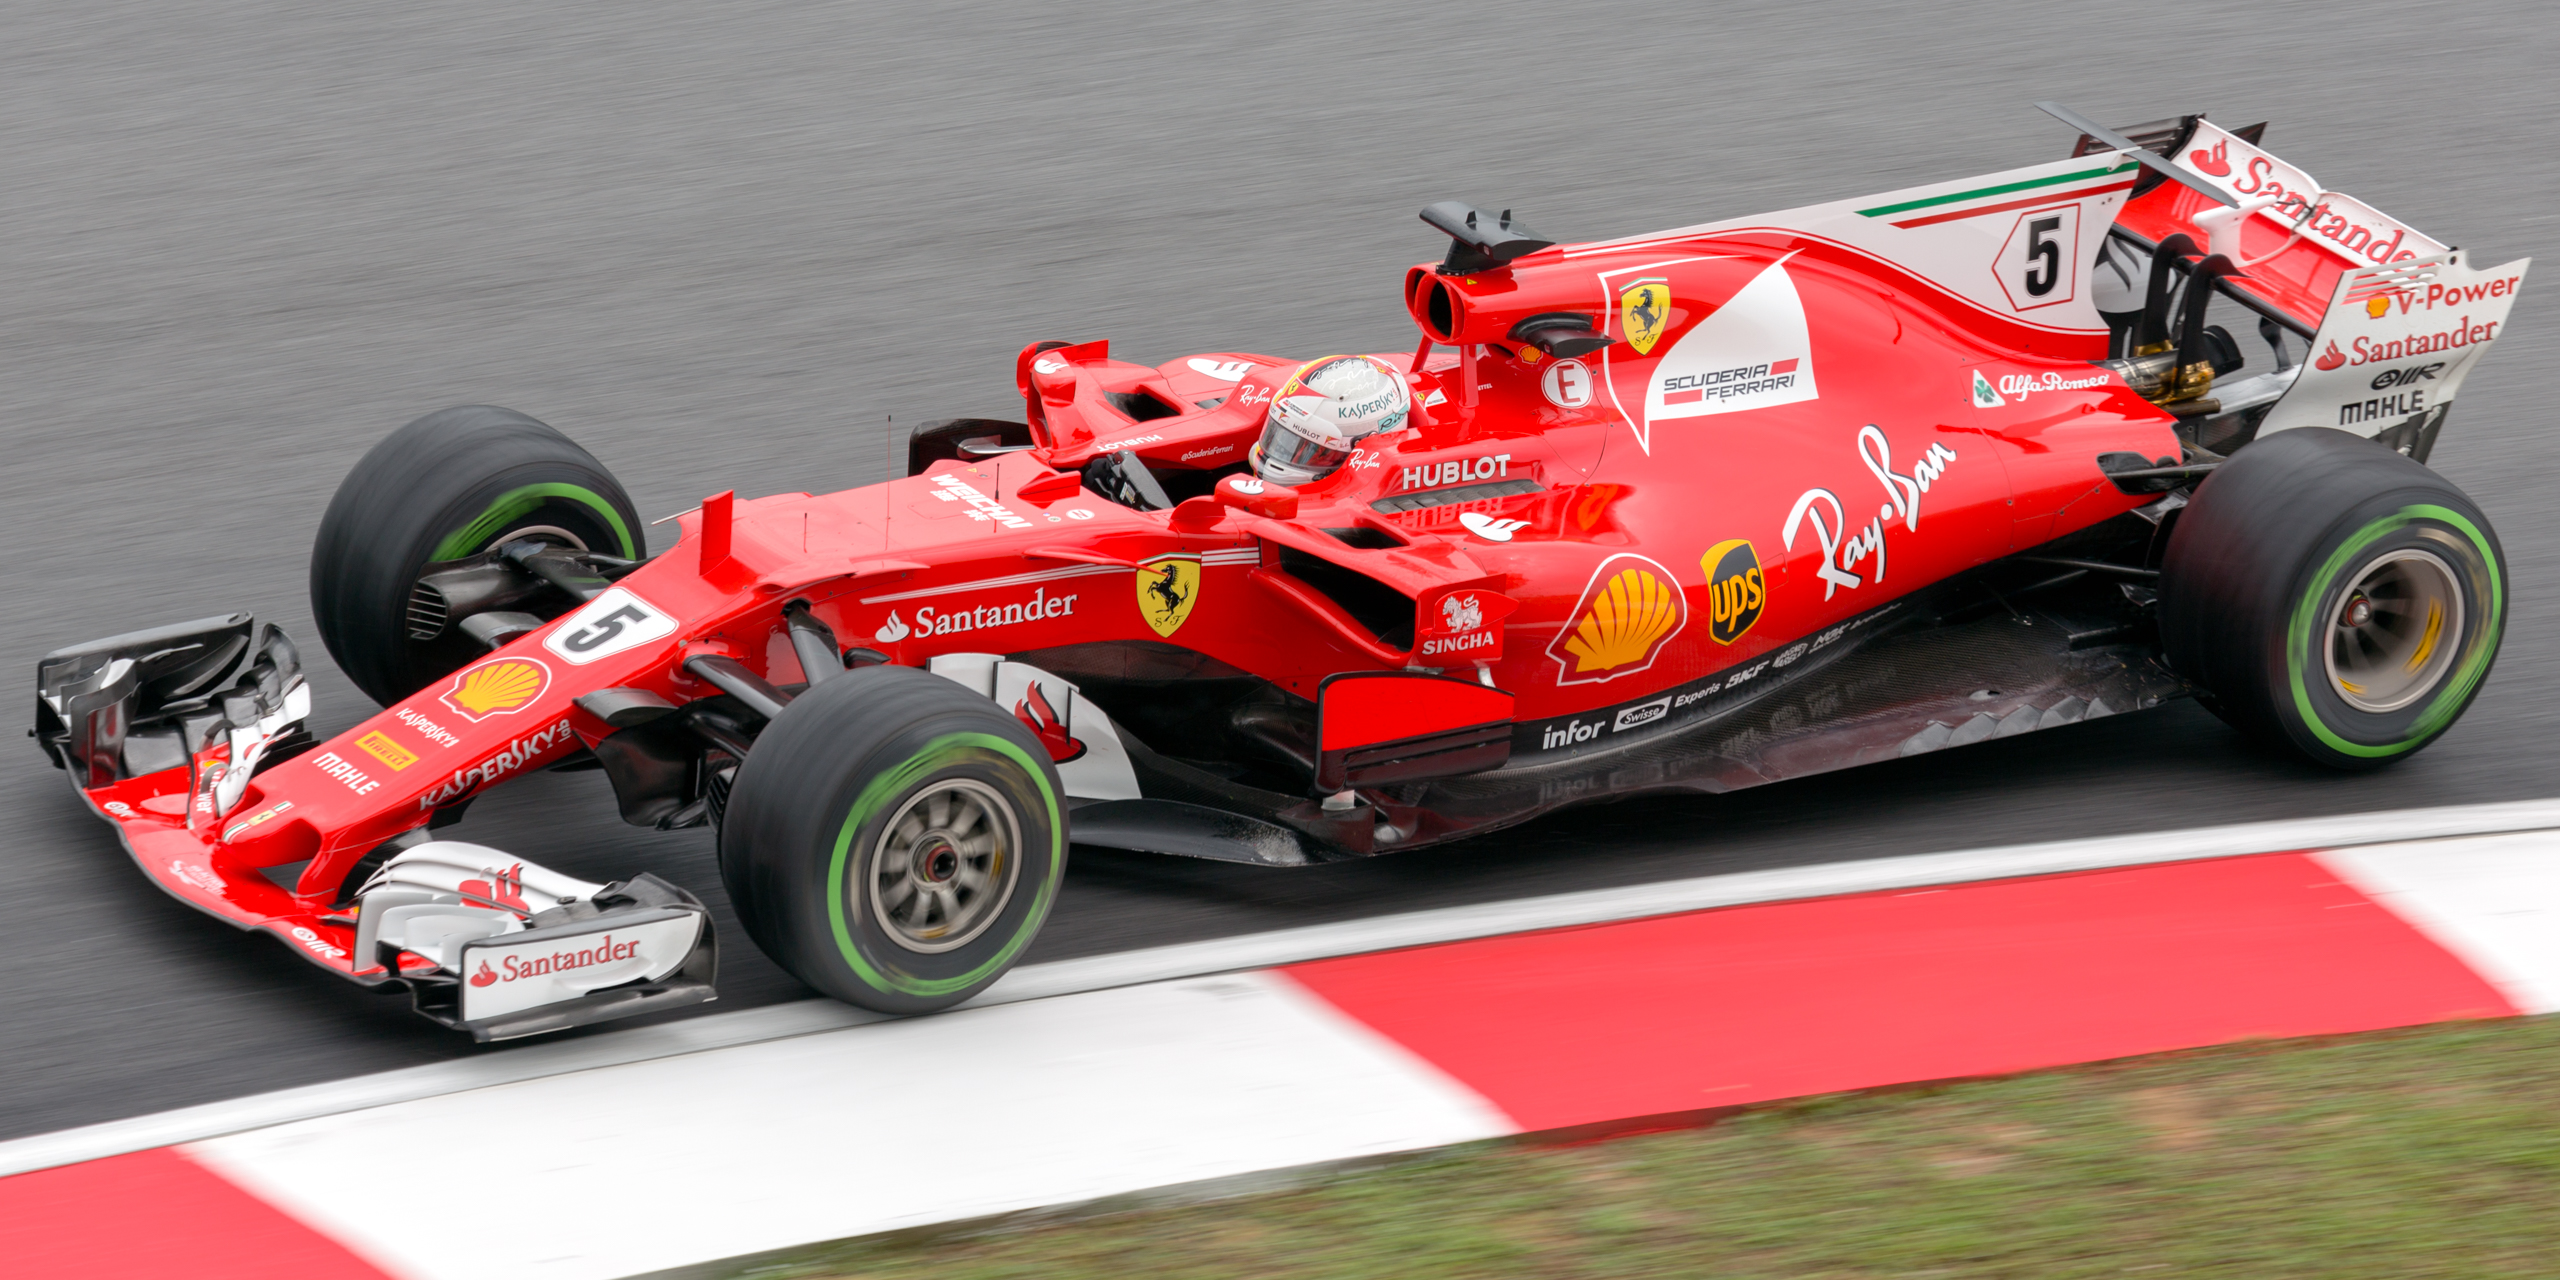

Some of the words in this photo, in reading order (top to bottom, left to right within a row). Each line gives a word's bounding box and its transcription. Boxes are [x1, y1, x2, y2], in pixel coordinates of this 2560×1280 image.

[2025, 214, 2062, 298] 5
[2396, 276, 2520, 315] V-Power
[2350, 315, 2498, 366] Santander
[1477, 383, 1493, 391] ETTEL
[1556, 363, 1582, 404] E
[1664, 363, 1769, 391] SCUDERIA
[1705, 374, 1796, 400] FERRARI
[1999, 374, 2044, 402] Alfa
[2042, 372, 2110, 390] Romeo
[1338, 389, 1394, 419] KASPERSKY
[2339, 389, 2425, 426] MAHLE
[1097, 434, 1163, 452] HUBLOT
[1292, 423, 1321, 440] HUBLOT
[1181, 444, 1234, 461] @ScuderiaFerrari
[1402, 453, 1511, 490] HUBLOT
[914, 587, 1078, 638] Santander
[1712, 567, 1762, 633] ups
[562, 602, 651, 653] 5
[1422, 631, 1494, 655] SINGHA
[1542, 719, 1606, 750] infor
[1624, 706, 1660, 724] Swisse
[1674, 682, 1721, 708] Experis
[1724, 660, 1770, 690] SKF
[396, 707, 454, 748] KASPERSKY
[363, 735, 411, 767] PIRELLI
[419, 724, 557, 811] KASPERSKY
[556, 719, 572, 743] lab
[312, 751, 381, 796] MAHLE
[502, 935, 640, 982] Santander
